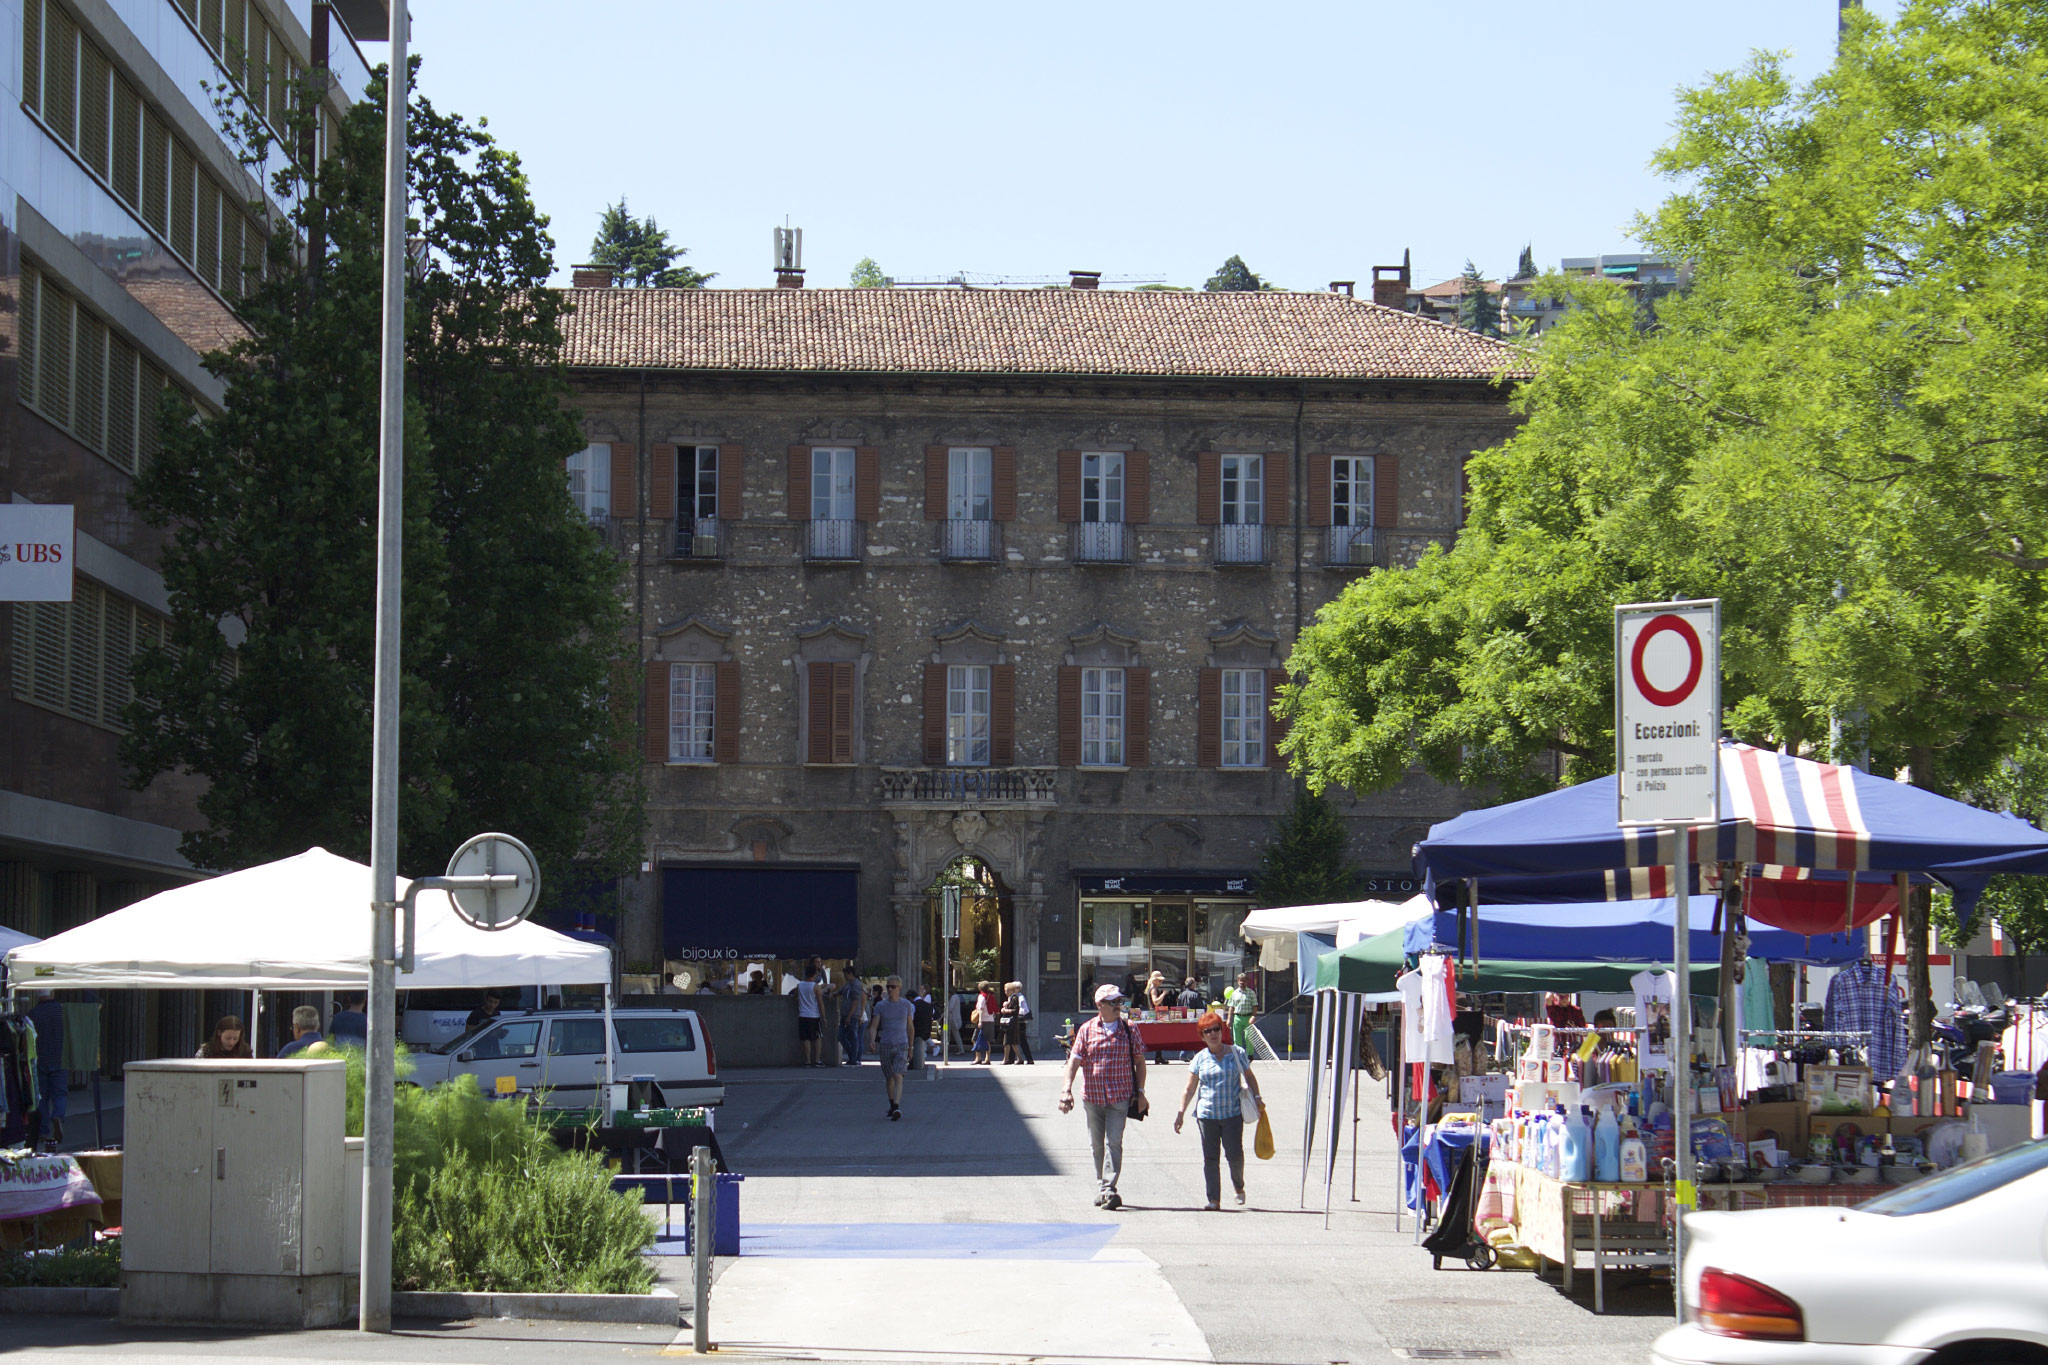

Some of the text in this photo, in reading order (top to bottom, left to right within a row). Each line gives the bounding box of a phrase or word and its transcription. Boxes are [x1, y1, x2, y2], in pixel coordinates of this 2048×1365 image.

[15, 543, 62, 563] UBS
[1635, 720, 1700, 740] Eccezioni:
[1636, 752, 1663, 763] mercato
[1636, 764, 1707, 778] con permesso scritto
[1644, 780, 1666, 791] Polizia
[682, 946, 723, 961] bijoux
[725, 946, 738, 959] io
